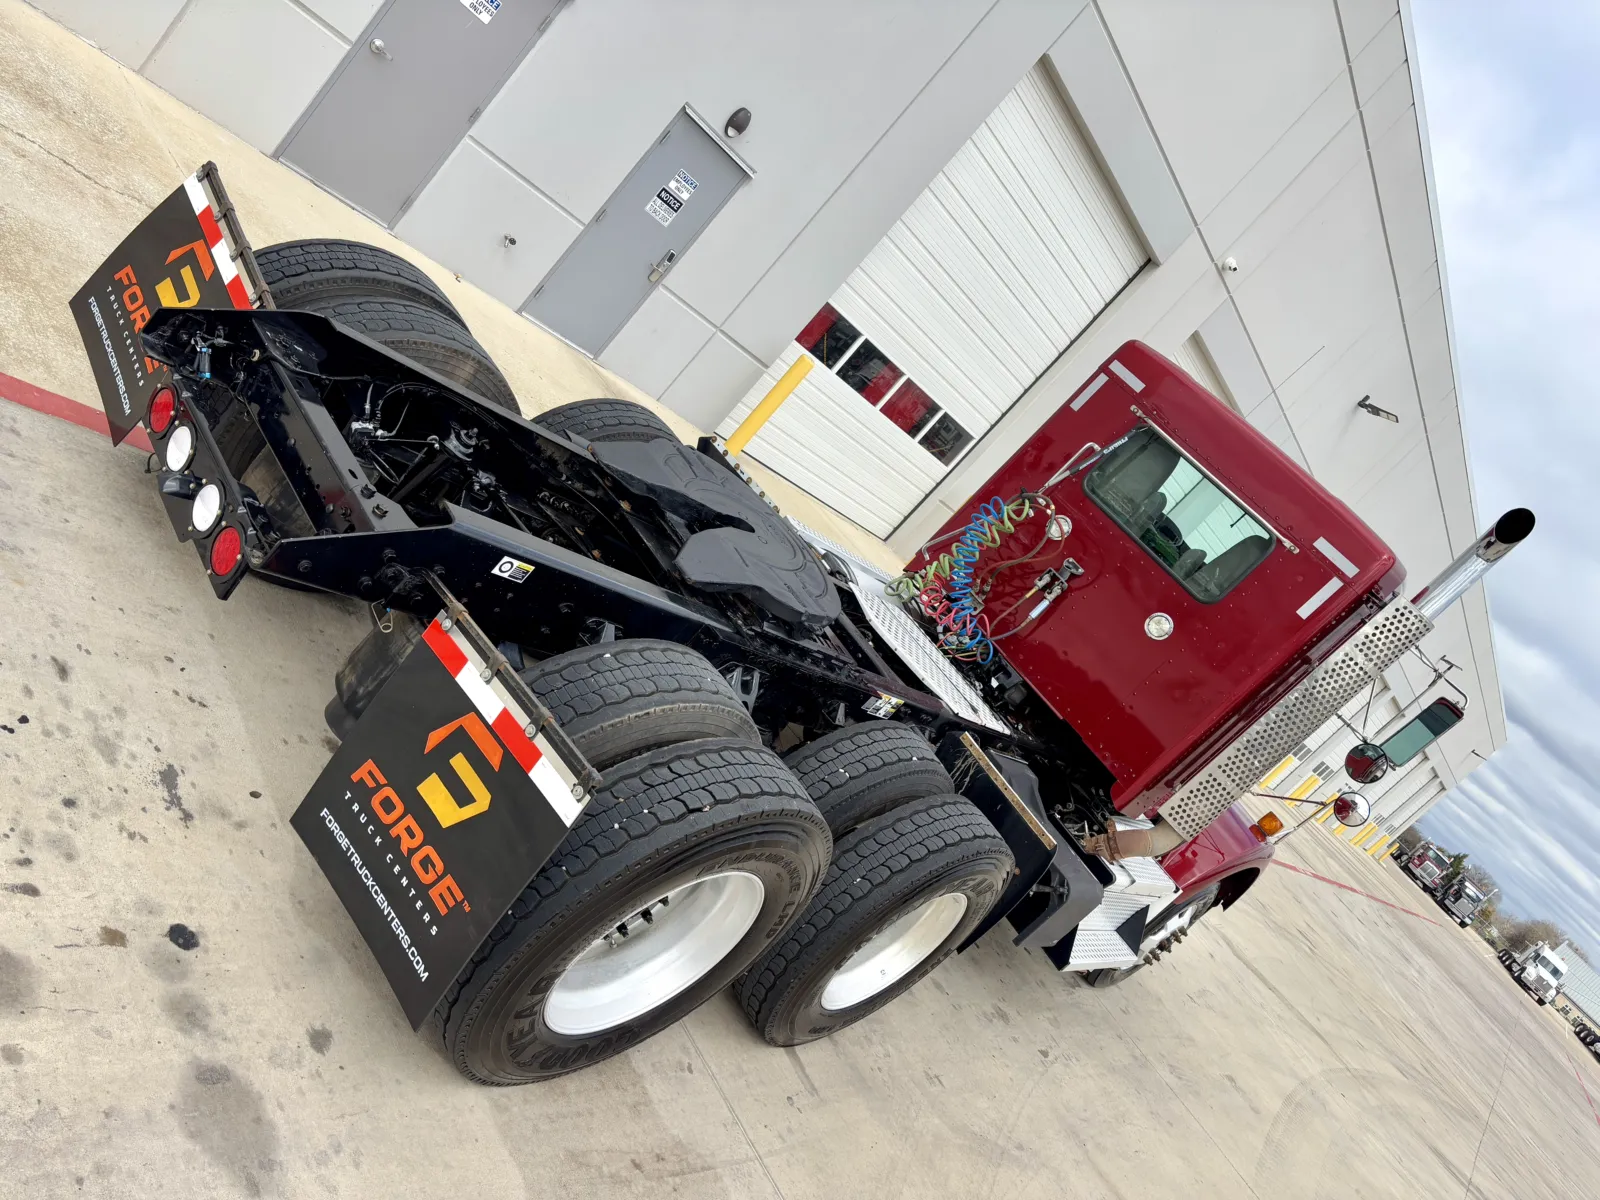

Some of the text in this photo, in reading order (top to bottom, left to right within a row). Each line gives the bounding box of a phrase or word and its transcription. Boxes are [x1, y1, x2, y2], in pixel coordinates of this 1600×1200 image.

[469, 2, 484, 16] ONLY
[473, 0, 495, 17] LOYEES
[672, 176, 693, 194] EMPLOYEES
[674, 185, 684, 194] ONLY
[677, 171, 697, 189] NOTICE
[659, 190, 680, 210] NOTICE
[106, 285, 145, 387] TRUCK CENTERS
[88, 296, 131, 416] FORGETRUCKCENTERS.COM
[344, 790, 438, 936] TRUCK CENTERS
[320, 807, 429, 982] FORGETRUCKCENTERS.COM
